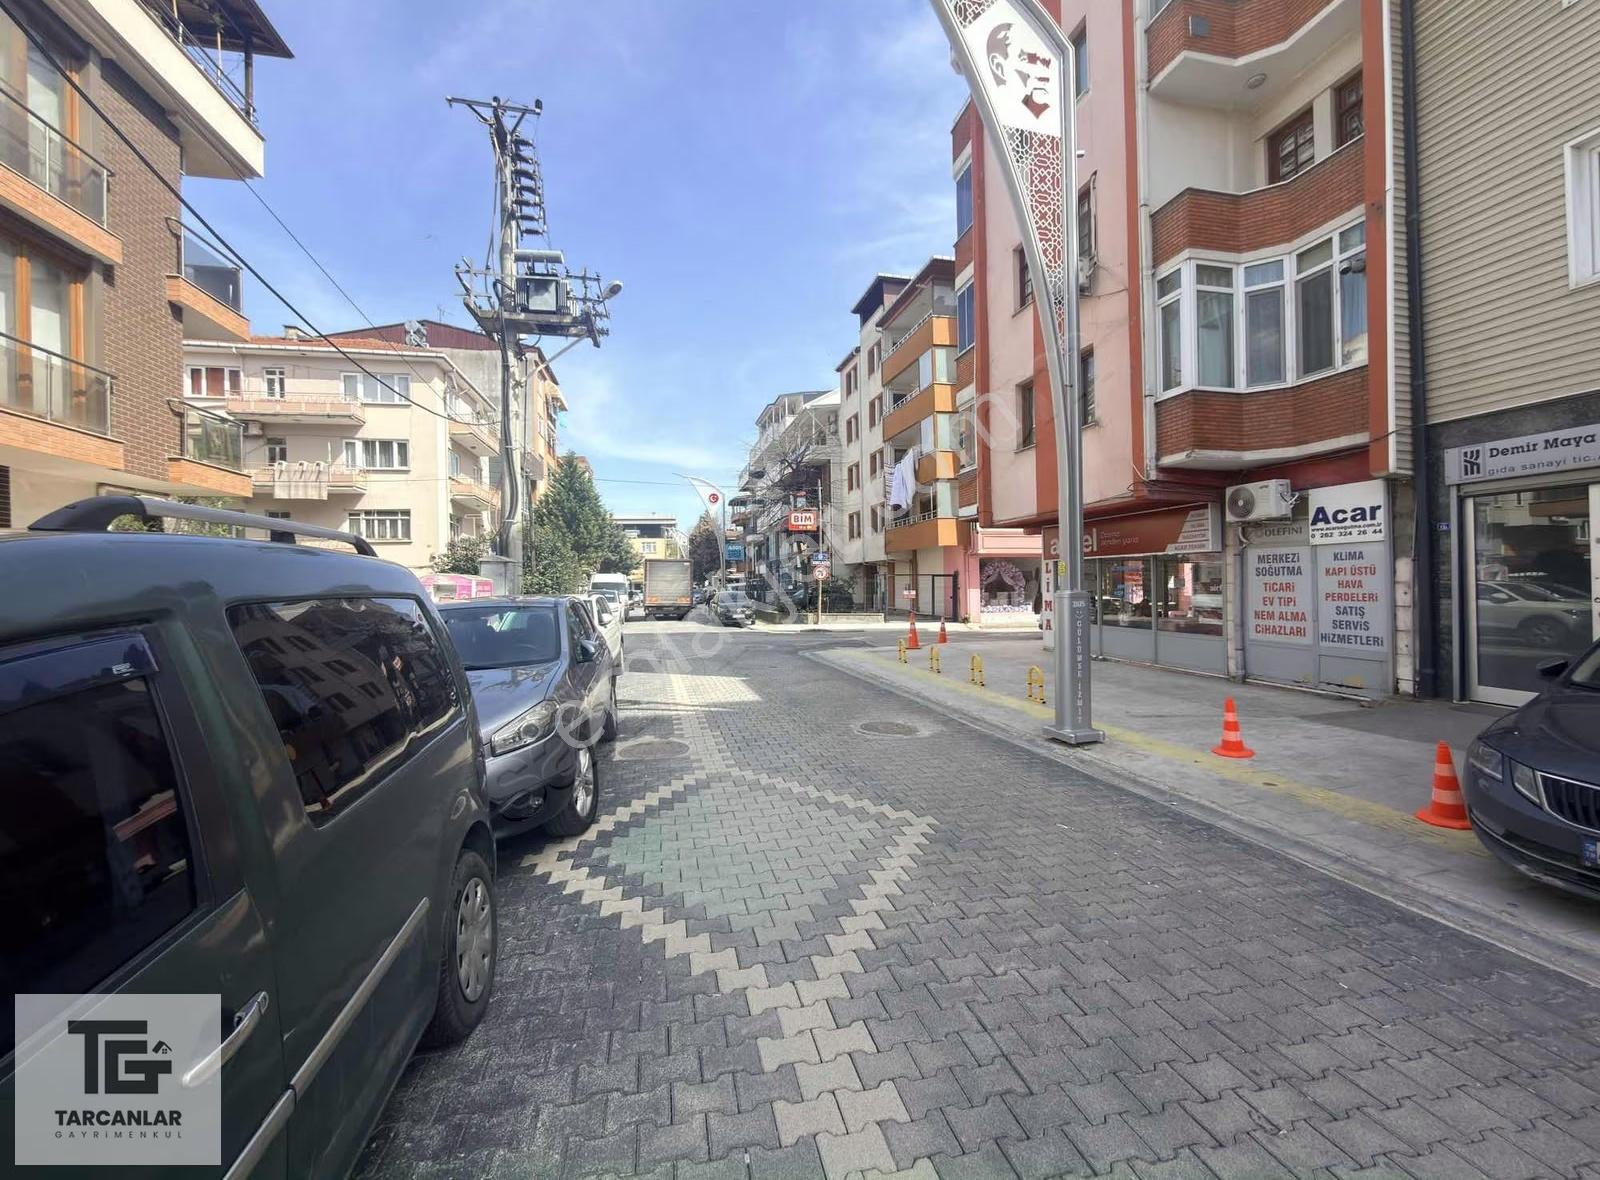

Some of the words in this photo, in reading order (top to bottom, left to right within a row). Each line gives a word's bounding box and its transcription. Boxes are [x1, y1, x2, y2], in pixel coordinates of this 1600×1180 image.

[1489, 442, 1538, 458] Demir
[1544, 433, 1597, 450] Maya
[1311, 505, 1382, 526] Acar
[1257, 552, 1300, 564] MERKEZİ
[1333, 551, 1364, 562] KLİMA
[1255, 564, 1303, 577] SOĞUTMA
[1325, 567, 1347, 576] KAPI
[1350, 564, 1376, 576] ÜSTÜ
[1263, 582, 1295, 593] TİCARİ
[1337, 580, 1363, 589] HAVA
[1263, 597, 1274, 606] EV
[1325, 592, 1378, 602] PERDELERİ
[1254, 610, 1275, 621] NEM
[1278, 611, 1307, 622] ALMA
[1335, 606, 1365, 619] SATIŞ
[1255, 623, 1306, 638] CİHAZLARI
[1332, 620, 1370, 632] SERVİS
[1320, 633, 1384, 648] HİZMETLERİ
